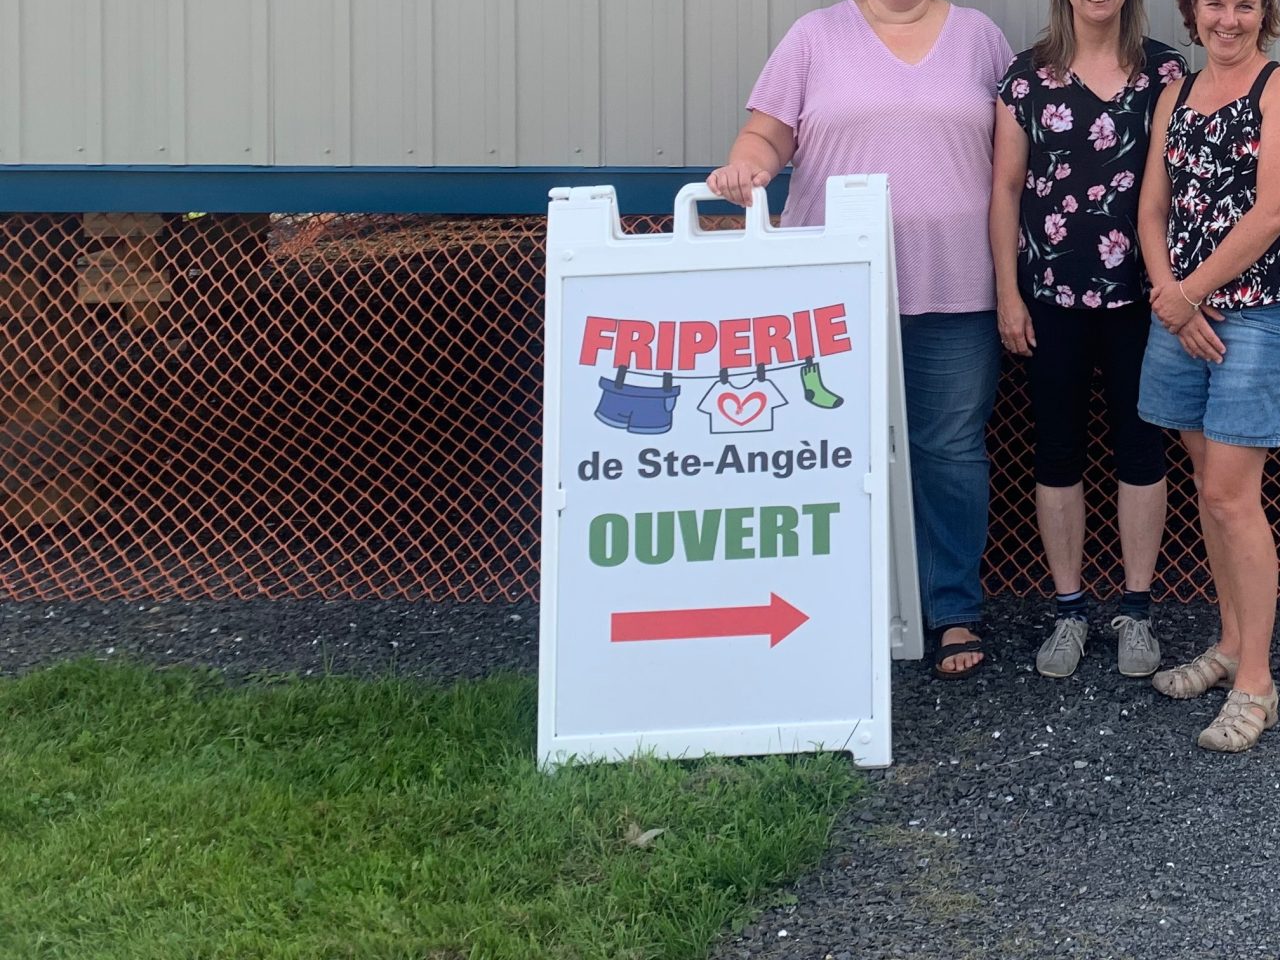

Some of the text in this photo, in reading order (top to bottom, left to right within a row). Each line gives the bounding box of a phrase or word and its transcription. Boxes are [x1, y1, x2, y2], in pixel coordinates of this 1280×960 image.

[579, 303, 852, 371] FRIPERIE
[577, 439, 853, 482] de Ste-Angèle
[589, 502, 841, 567] OUVERT
